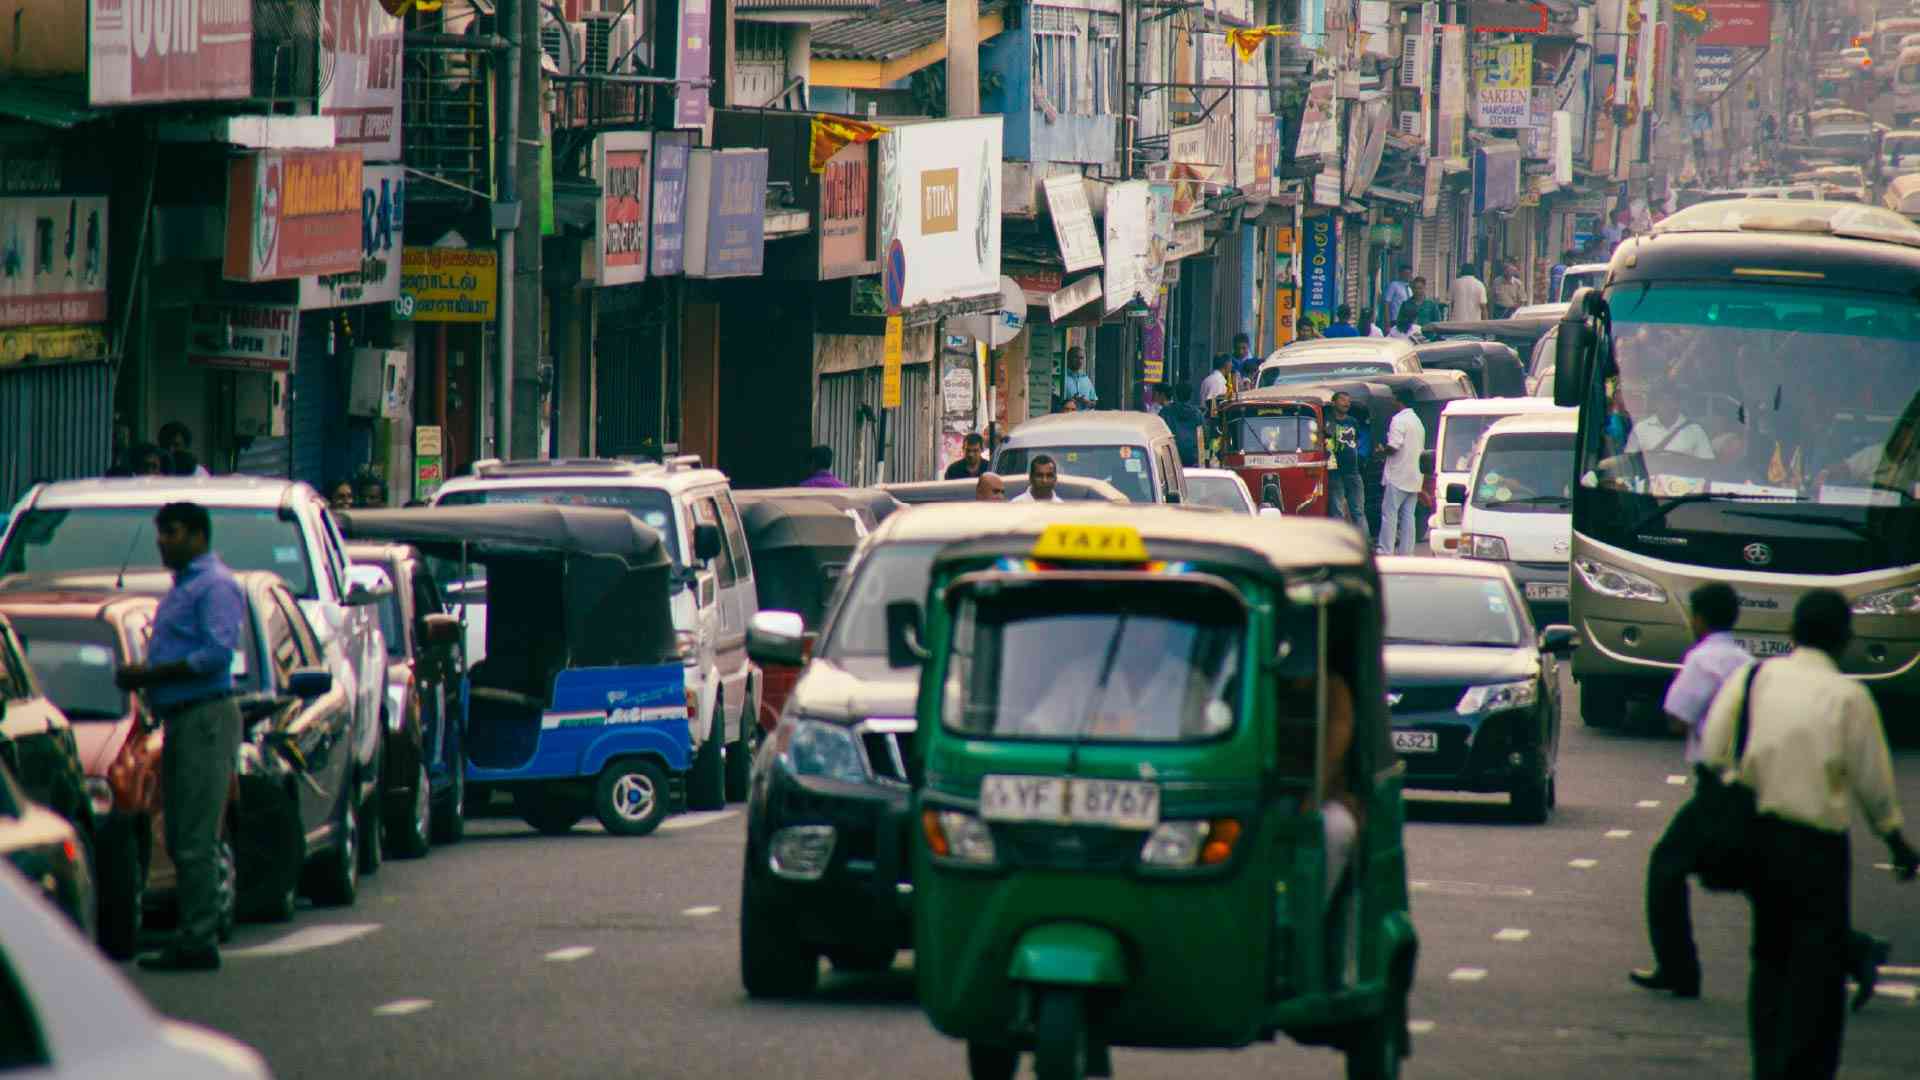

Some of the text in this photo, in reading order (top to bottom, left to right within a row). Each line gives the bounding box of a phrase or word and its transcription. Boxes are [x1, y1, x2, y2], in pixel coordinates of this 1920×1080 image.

[395, 295, 414, 315] 09
[1056, 531, 1128, 549] TAXI
[1396, 733, 1435, 749] 6321
[1084, 784, 1156, 812] 8767
